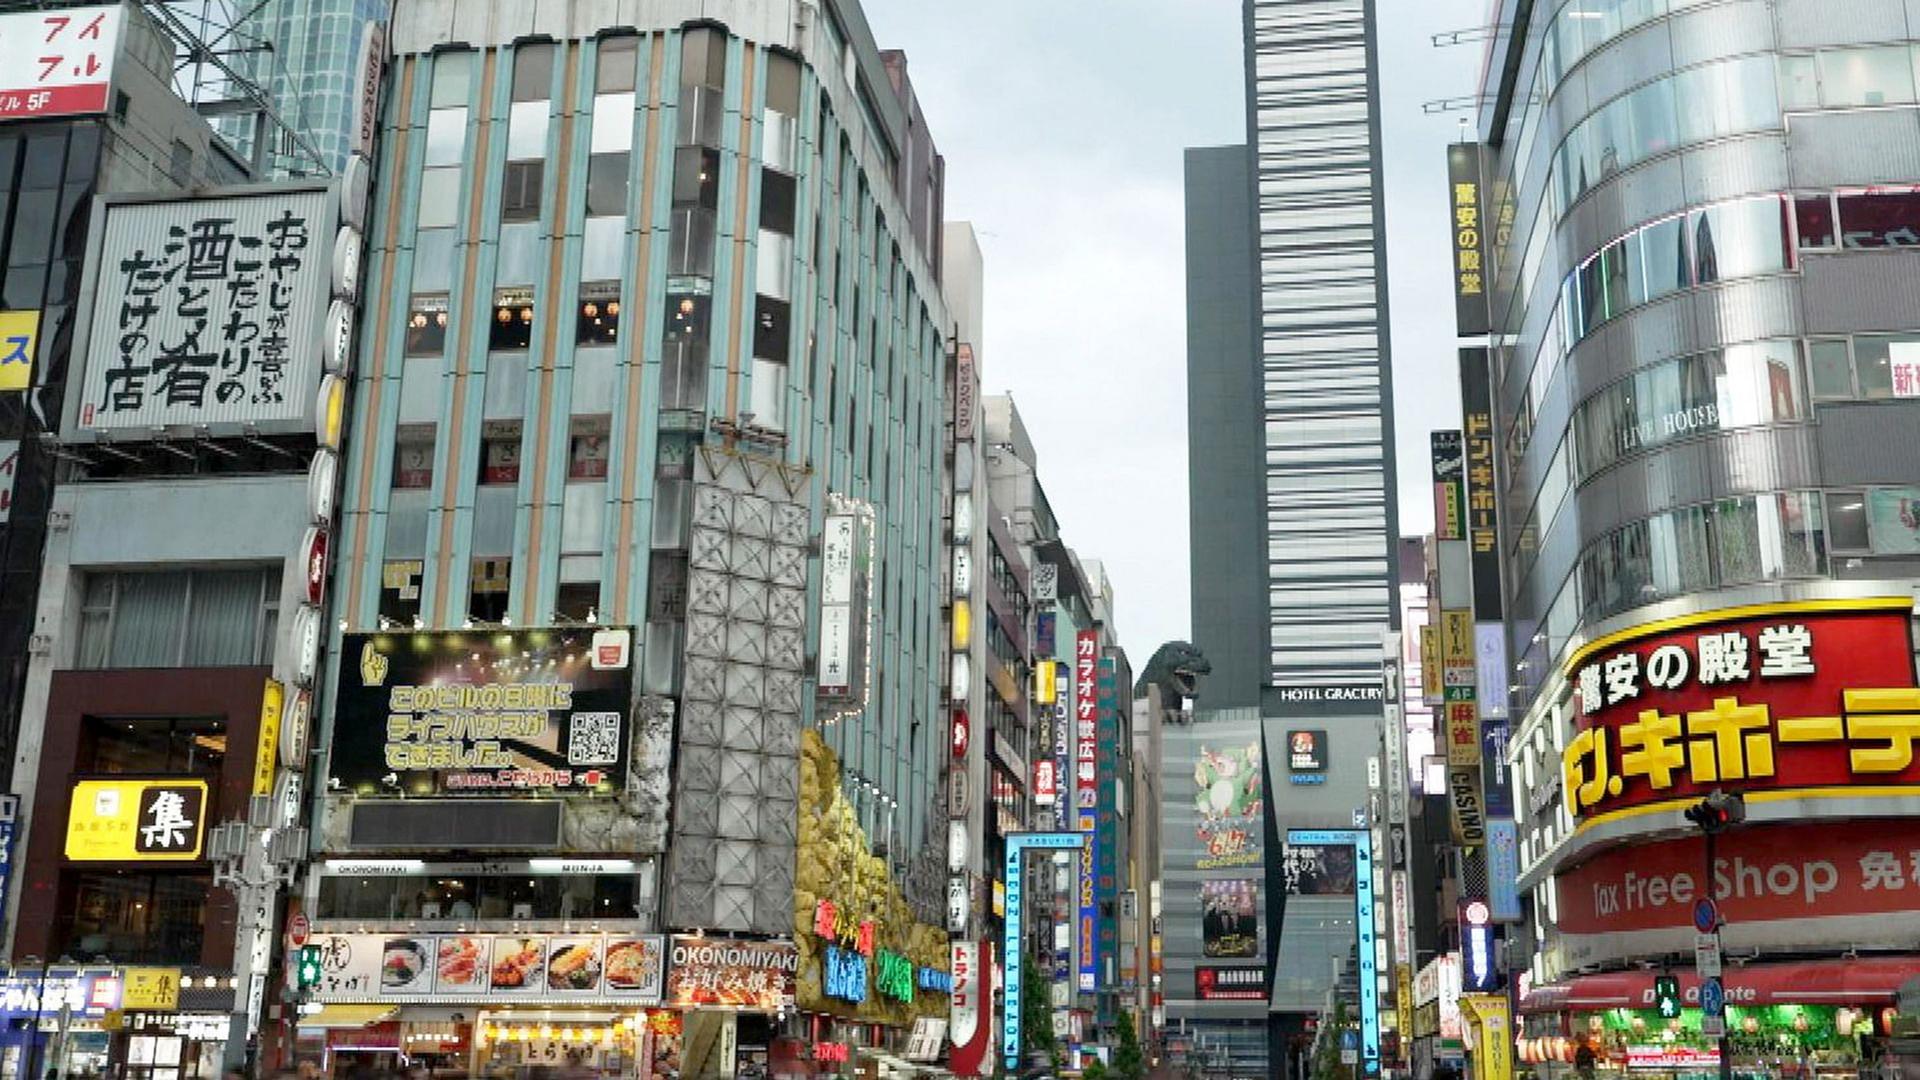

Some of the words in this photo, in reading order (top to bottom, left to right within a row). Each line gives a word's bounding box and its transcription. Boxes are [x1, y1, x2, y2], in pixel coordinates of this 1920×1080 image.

[43, 14, 106, 42] アイ
[38, 54, 101, 82] フル
[27, 92, 50, 110] 5F
[1455, 183, 1481, 293] 驚安の殿堂
[98, 249, 170, 413] だけの店
[216, 236, 262, 404] こだわりの
[1663, 402, 1720, 434] HOUSE
[1281, 688, 1321, 701] HOTEL
[1324, 687, 1383, 701] GRACERY
[1577, 624, 1815, 714] 驚安の殿堂
[140, 790, 195, 848] 集
[1451, 772, 1484, 840] CASINO
[1593, 883, 1620, 916] Tax
[1624, 872, 1695, 908] Free
[1713, 856, 1839, 904] Shop
[1858, 851, 1920, 891] 免
[673, 946, 799, 972] OKONOMIYAKI
